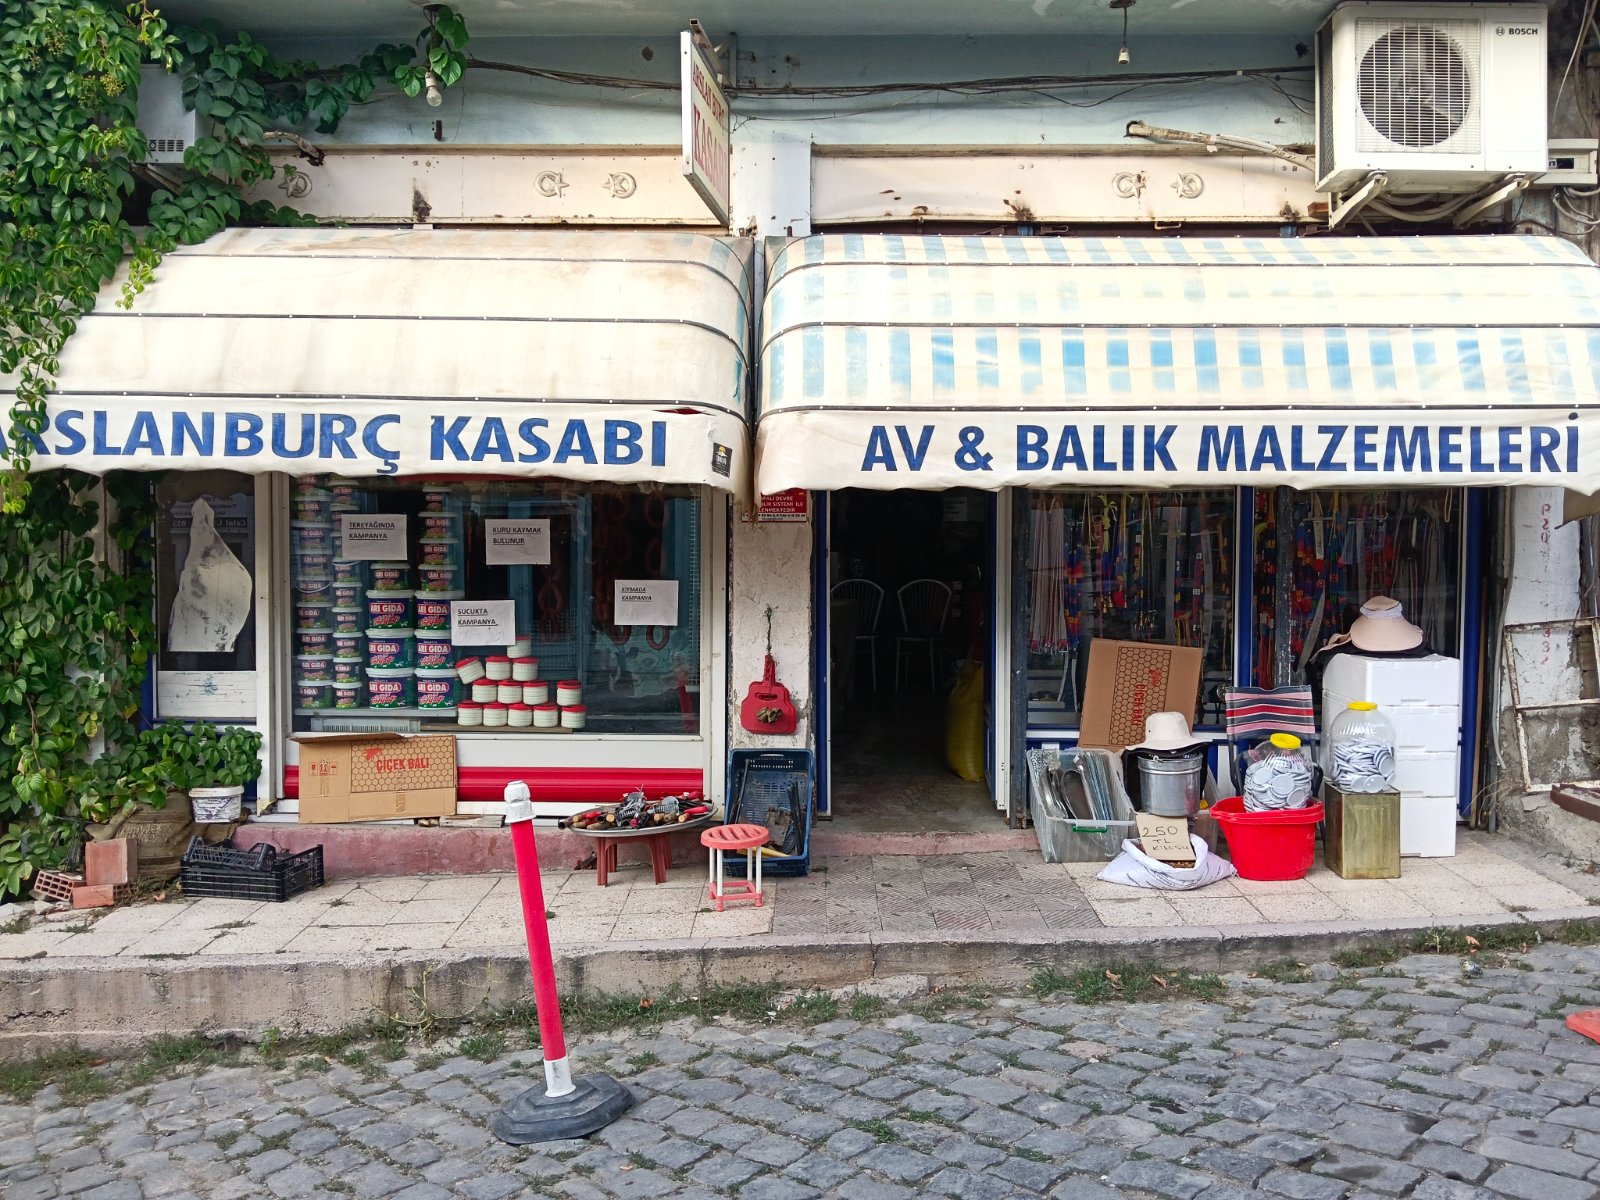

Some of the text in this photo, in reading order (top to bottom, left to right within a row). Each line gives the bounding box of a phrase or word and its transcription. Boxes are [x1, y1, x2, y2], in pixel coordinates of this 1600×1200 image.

[430, 416, 667, 466] KASABI
[861, 412, 1579, 472] AV & BALIK MALZEMELERİ
[349, 519, 395, 529] TEREYAĞINDA
[382, 603, 402, 612] GIDA
[427, 605, 448, 614] GIDA
[377, 643, 397, 653] GIDA
[428, 644, 449, 653] GIDA
[379, 683, 399, 692] GIDA
[427, 683, 446, 692] GIDA
[376, 757, 430, 774] ÇİÇEK BALI
[1142, 826, 1178, 838] 250
